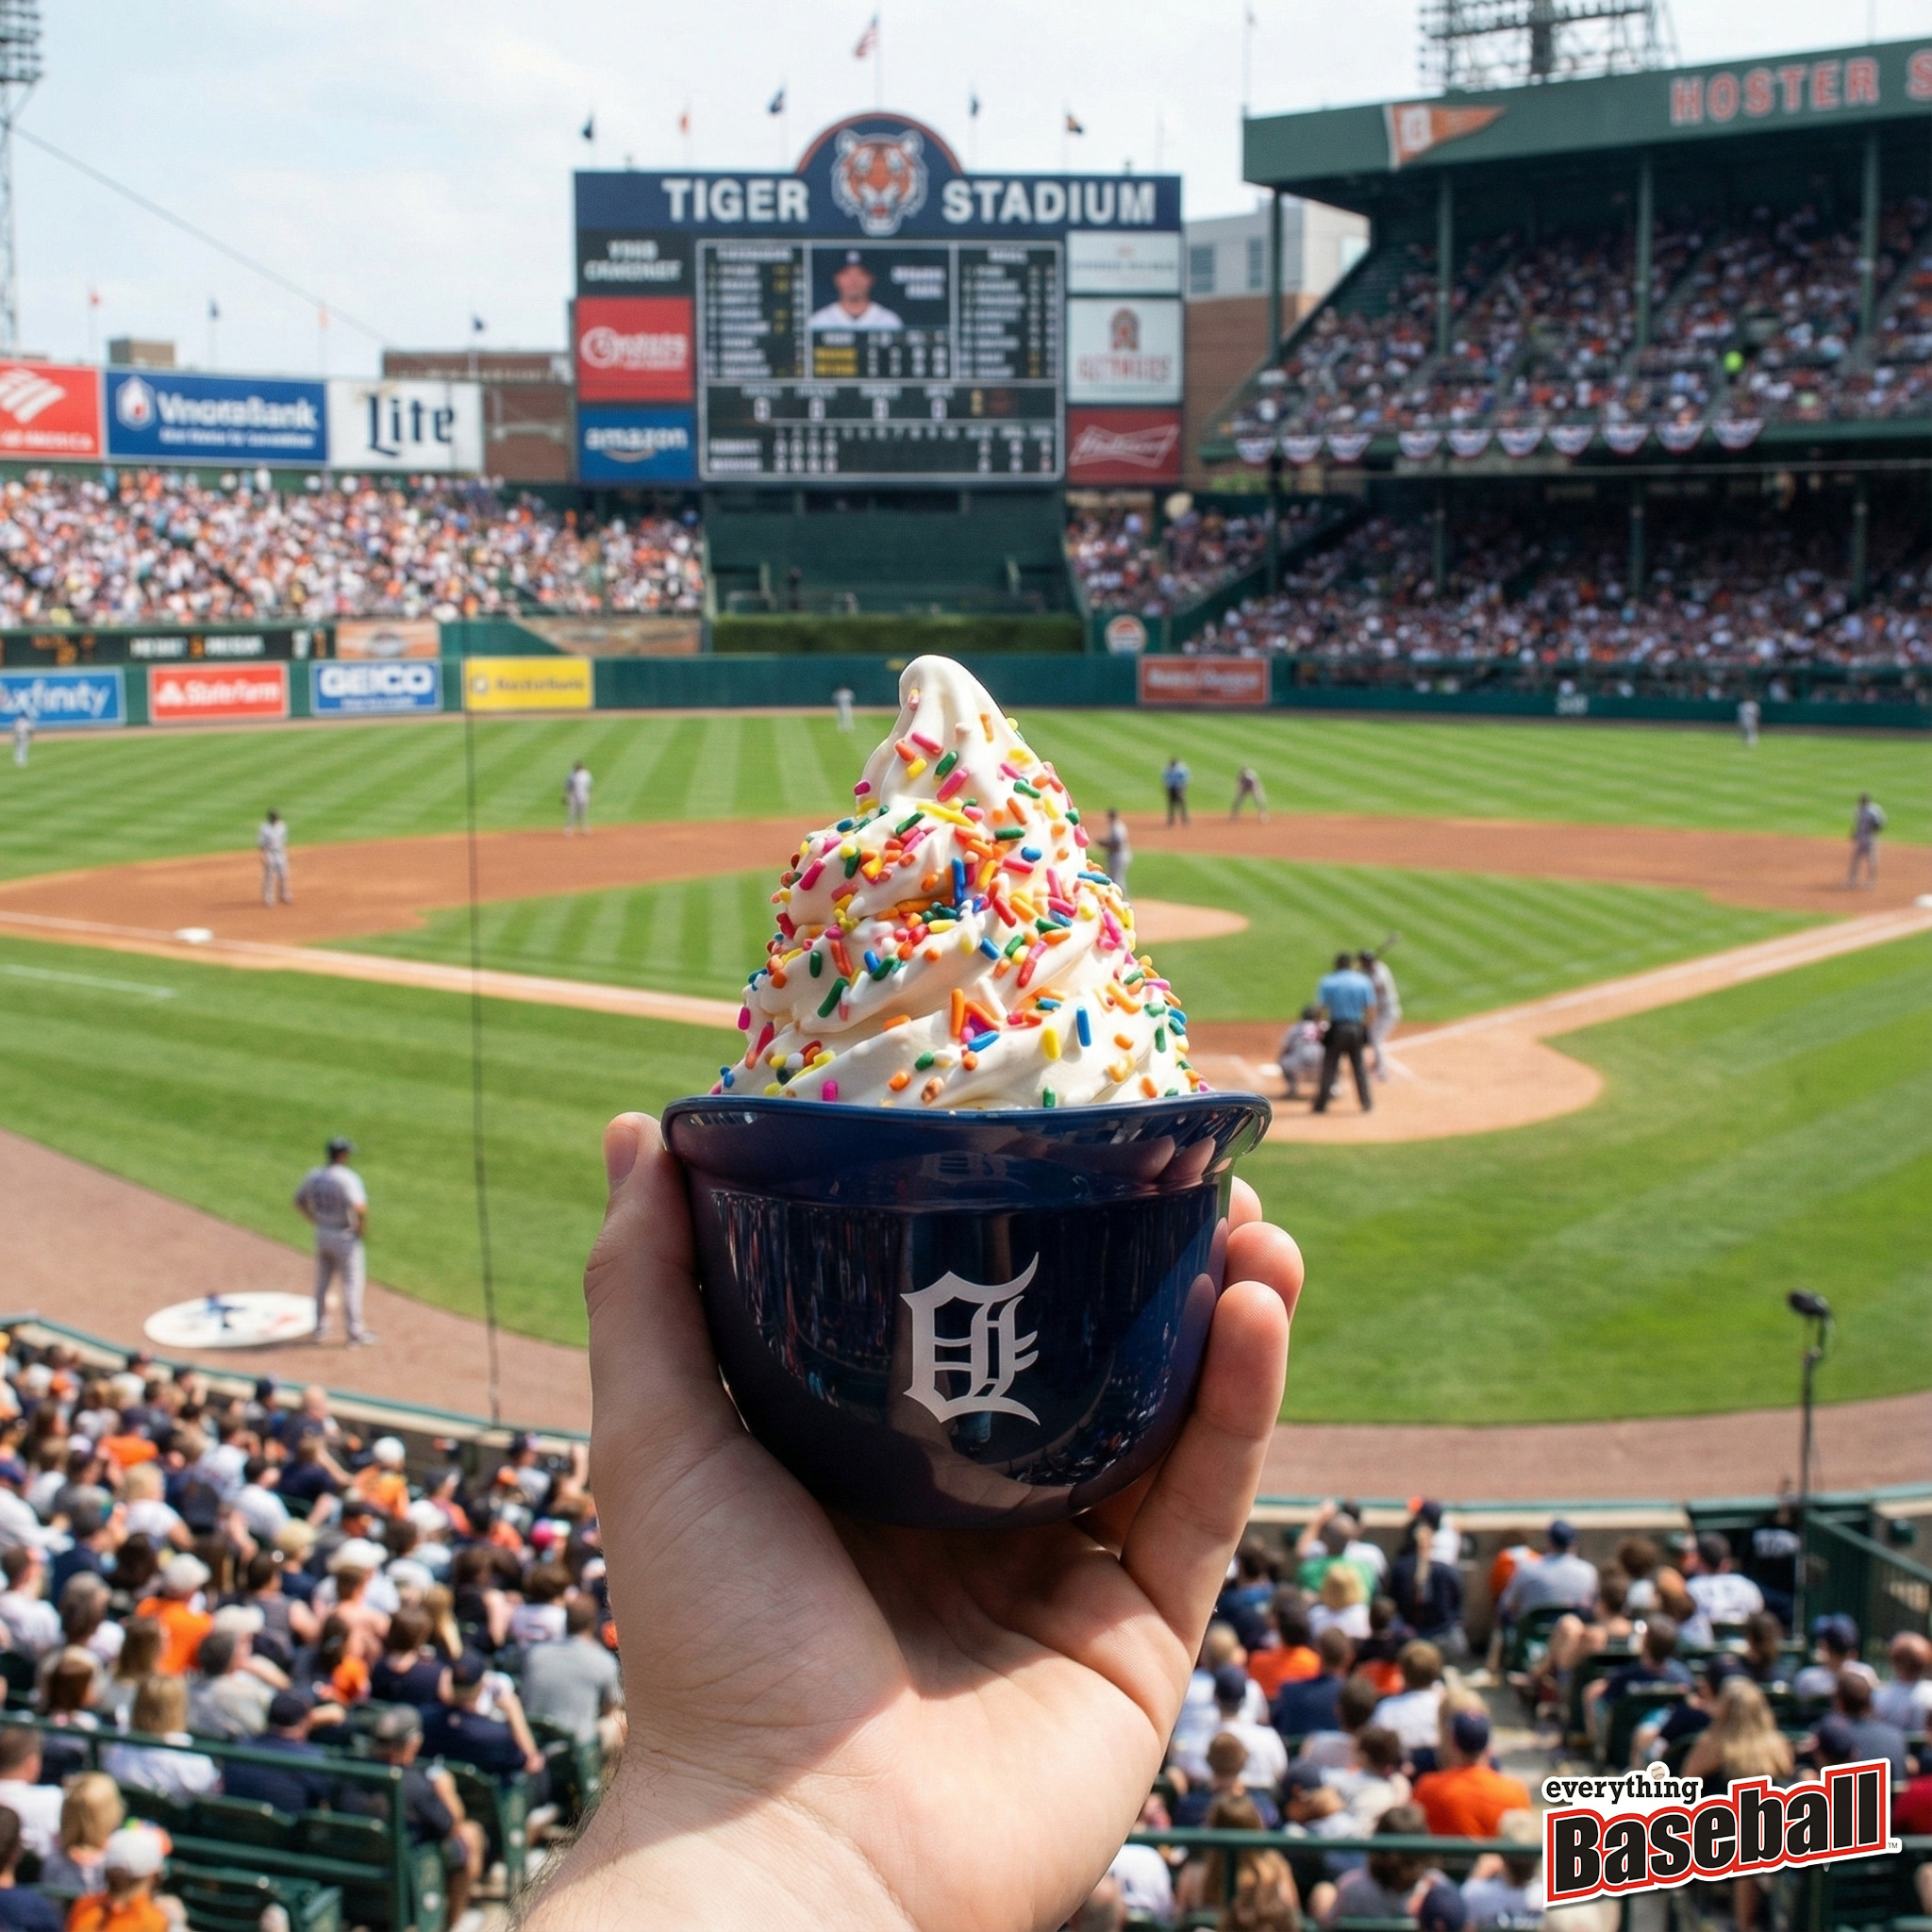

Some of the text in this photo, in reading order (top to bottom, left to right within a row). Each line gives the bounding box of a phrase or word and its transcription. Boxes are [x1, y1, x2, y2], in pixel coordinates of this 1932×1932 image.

[1671, 57, 1880, 125] HOSTER
[662, 179, 1157, 225] TIGER STADIUM
[368, 393, 453, 458] Lite
[585, 427, 689, 451] amazon
[319, 664, 433, 697] GEICO
